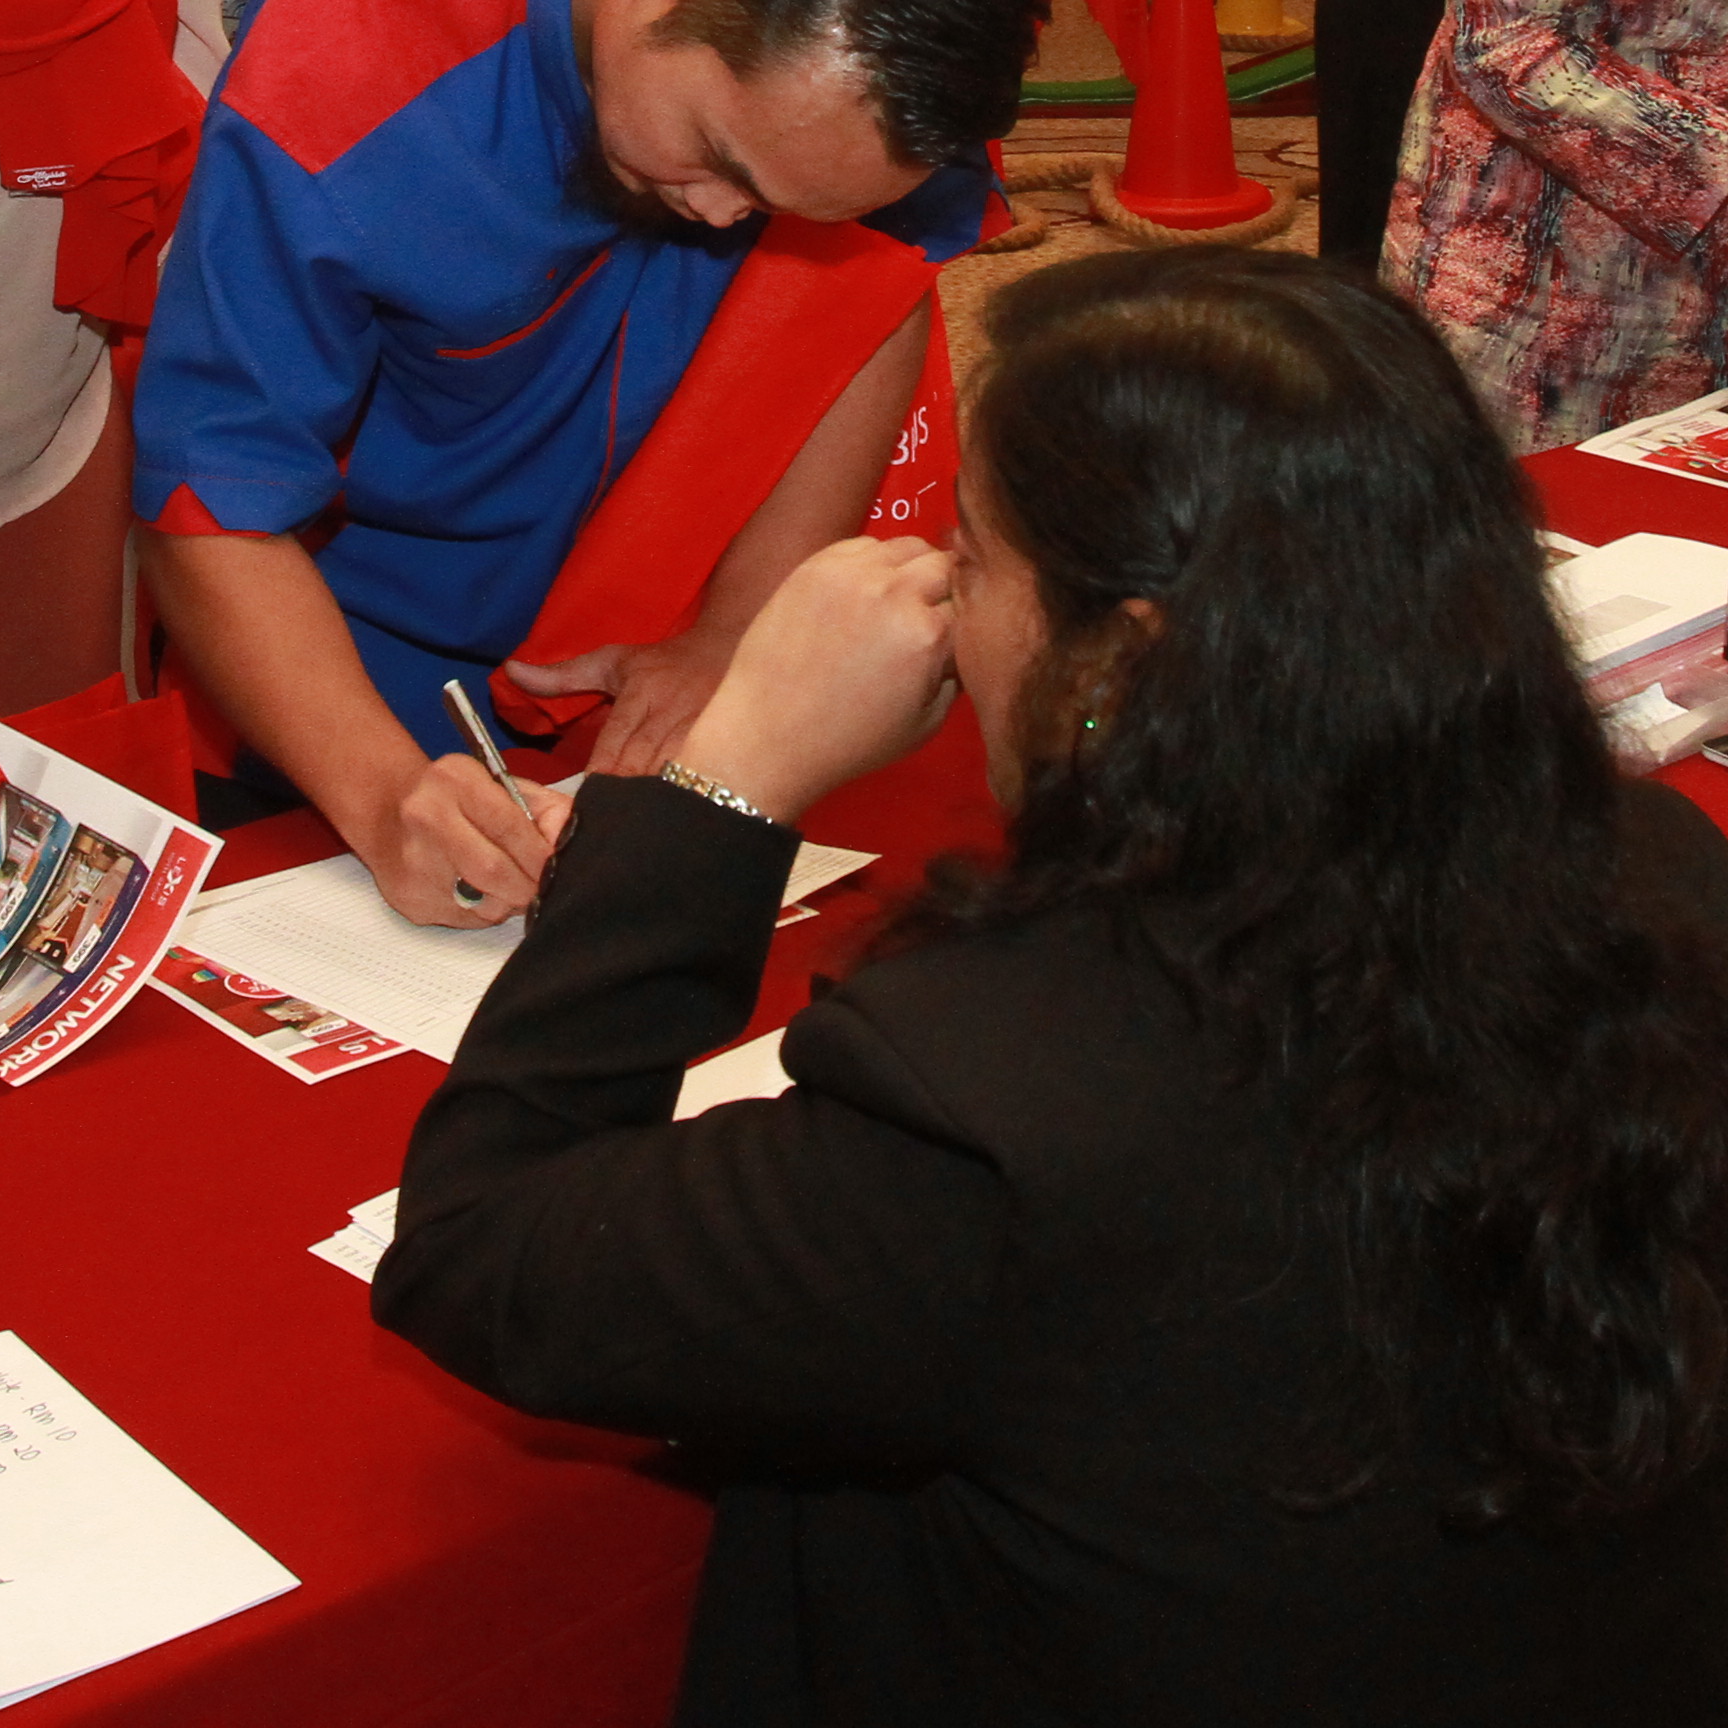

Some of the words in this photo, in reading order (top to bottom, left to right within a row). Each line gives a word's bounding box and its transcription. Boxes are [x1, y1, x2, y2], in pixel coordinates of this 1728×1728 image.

[158, 857, 186, 908] LEXIS
[23, 1403, 55, 1425] RM
[48, 1426, 77, 1442] 10
[14, 1444, 41, 1461] 20
